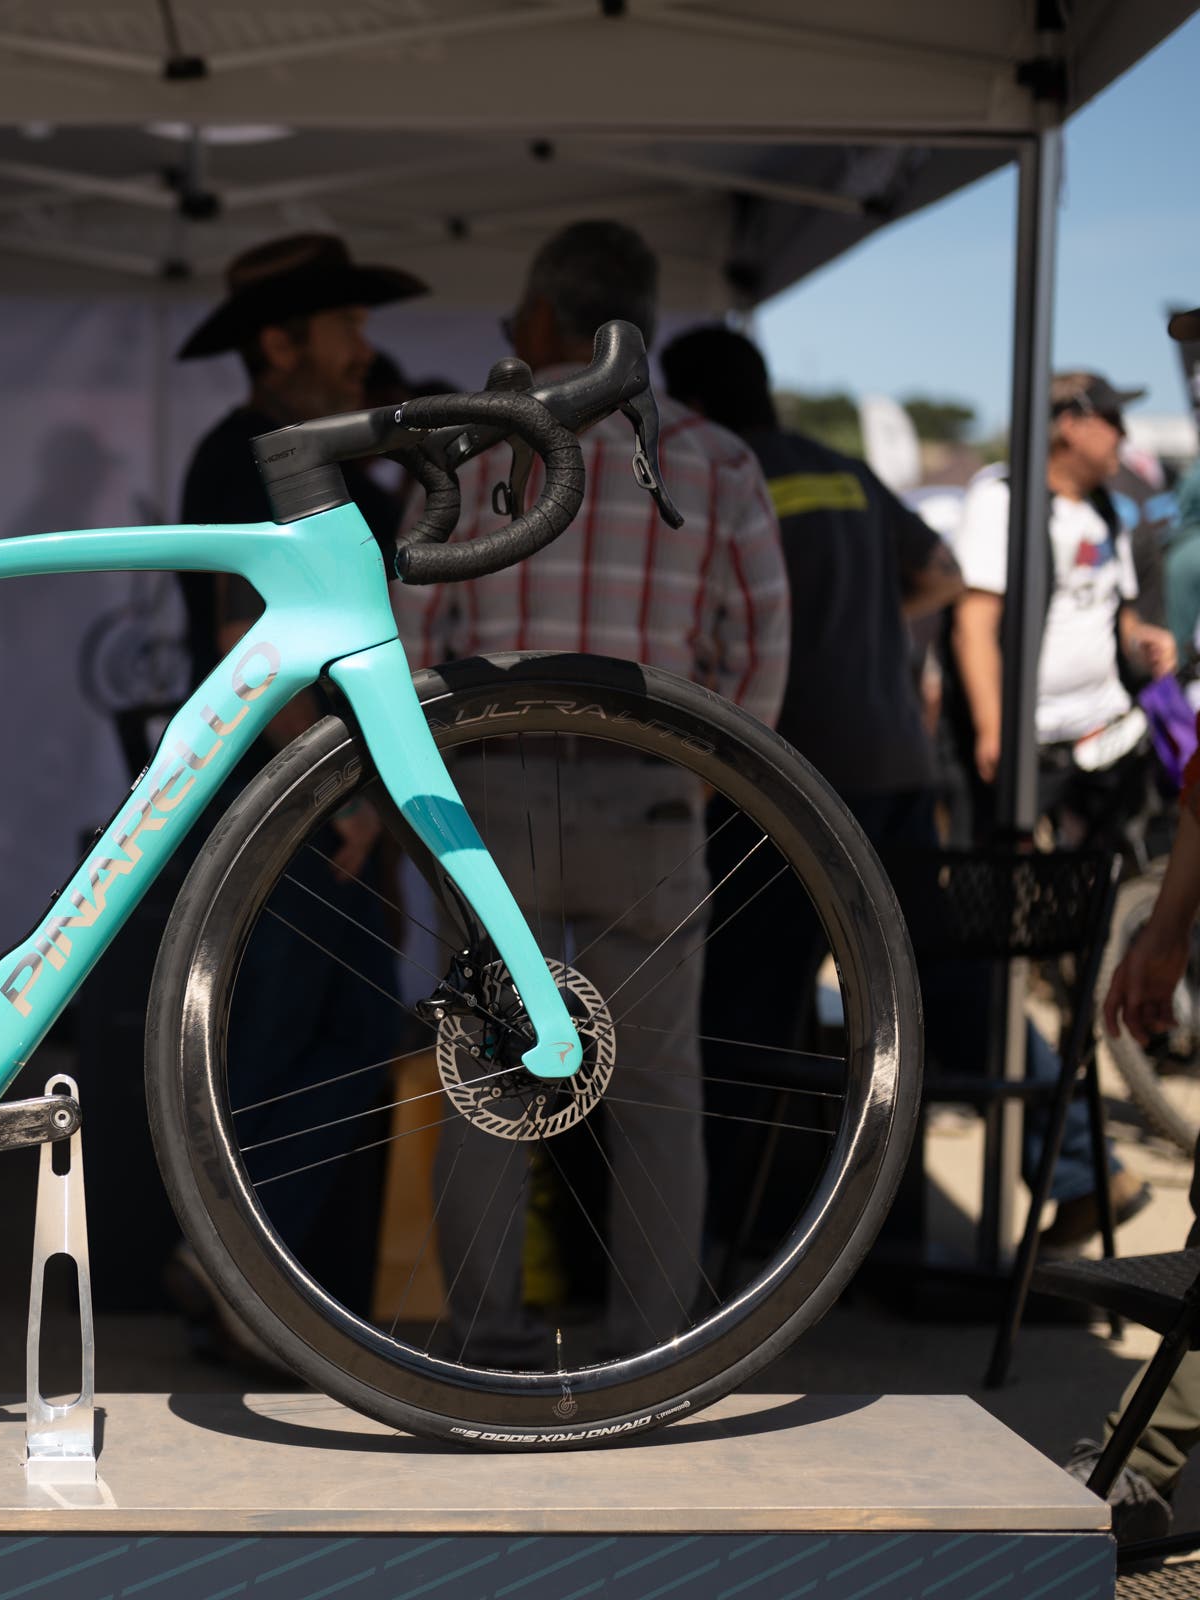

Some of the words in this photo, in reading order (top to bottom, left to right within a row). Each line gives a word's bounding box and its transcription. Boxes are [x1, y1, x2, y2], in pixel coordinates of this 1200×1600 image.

[455, 700, 607, 725] ULTRA
[0, 641, 281, 1018] PINARELLO
[479, 1431, 537, 1443] 5000
[538, 1431, 587, 1443] PRIX
[586, 1416, 651, 1437] GRAND
